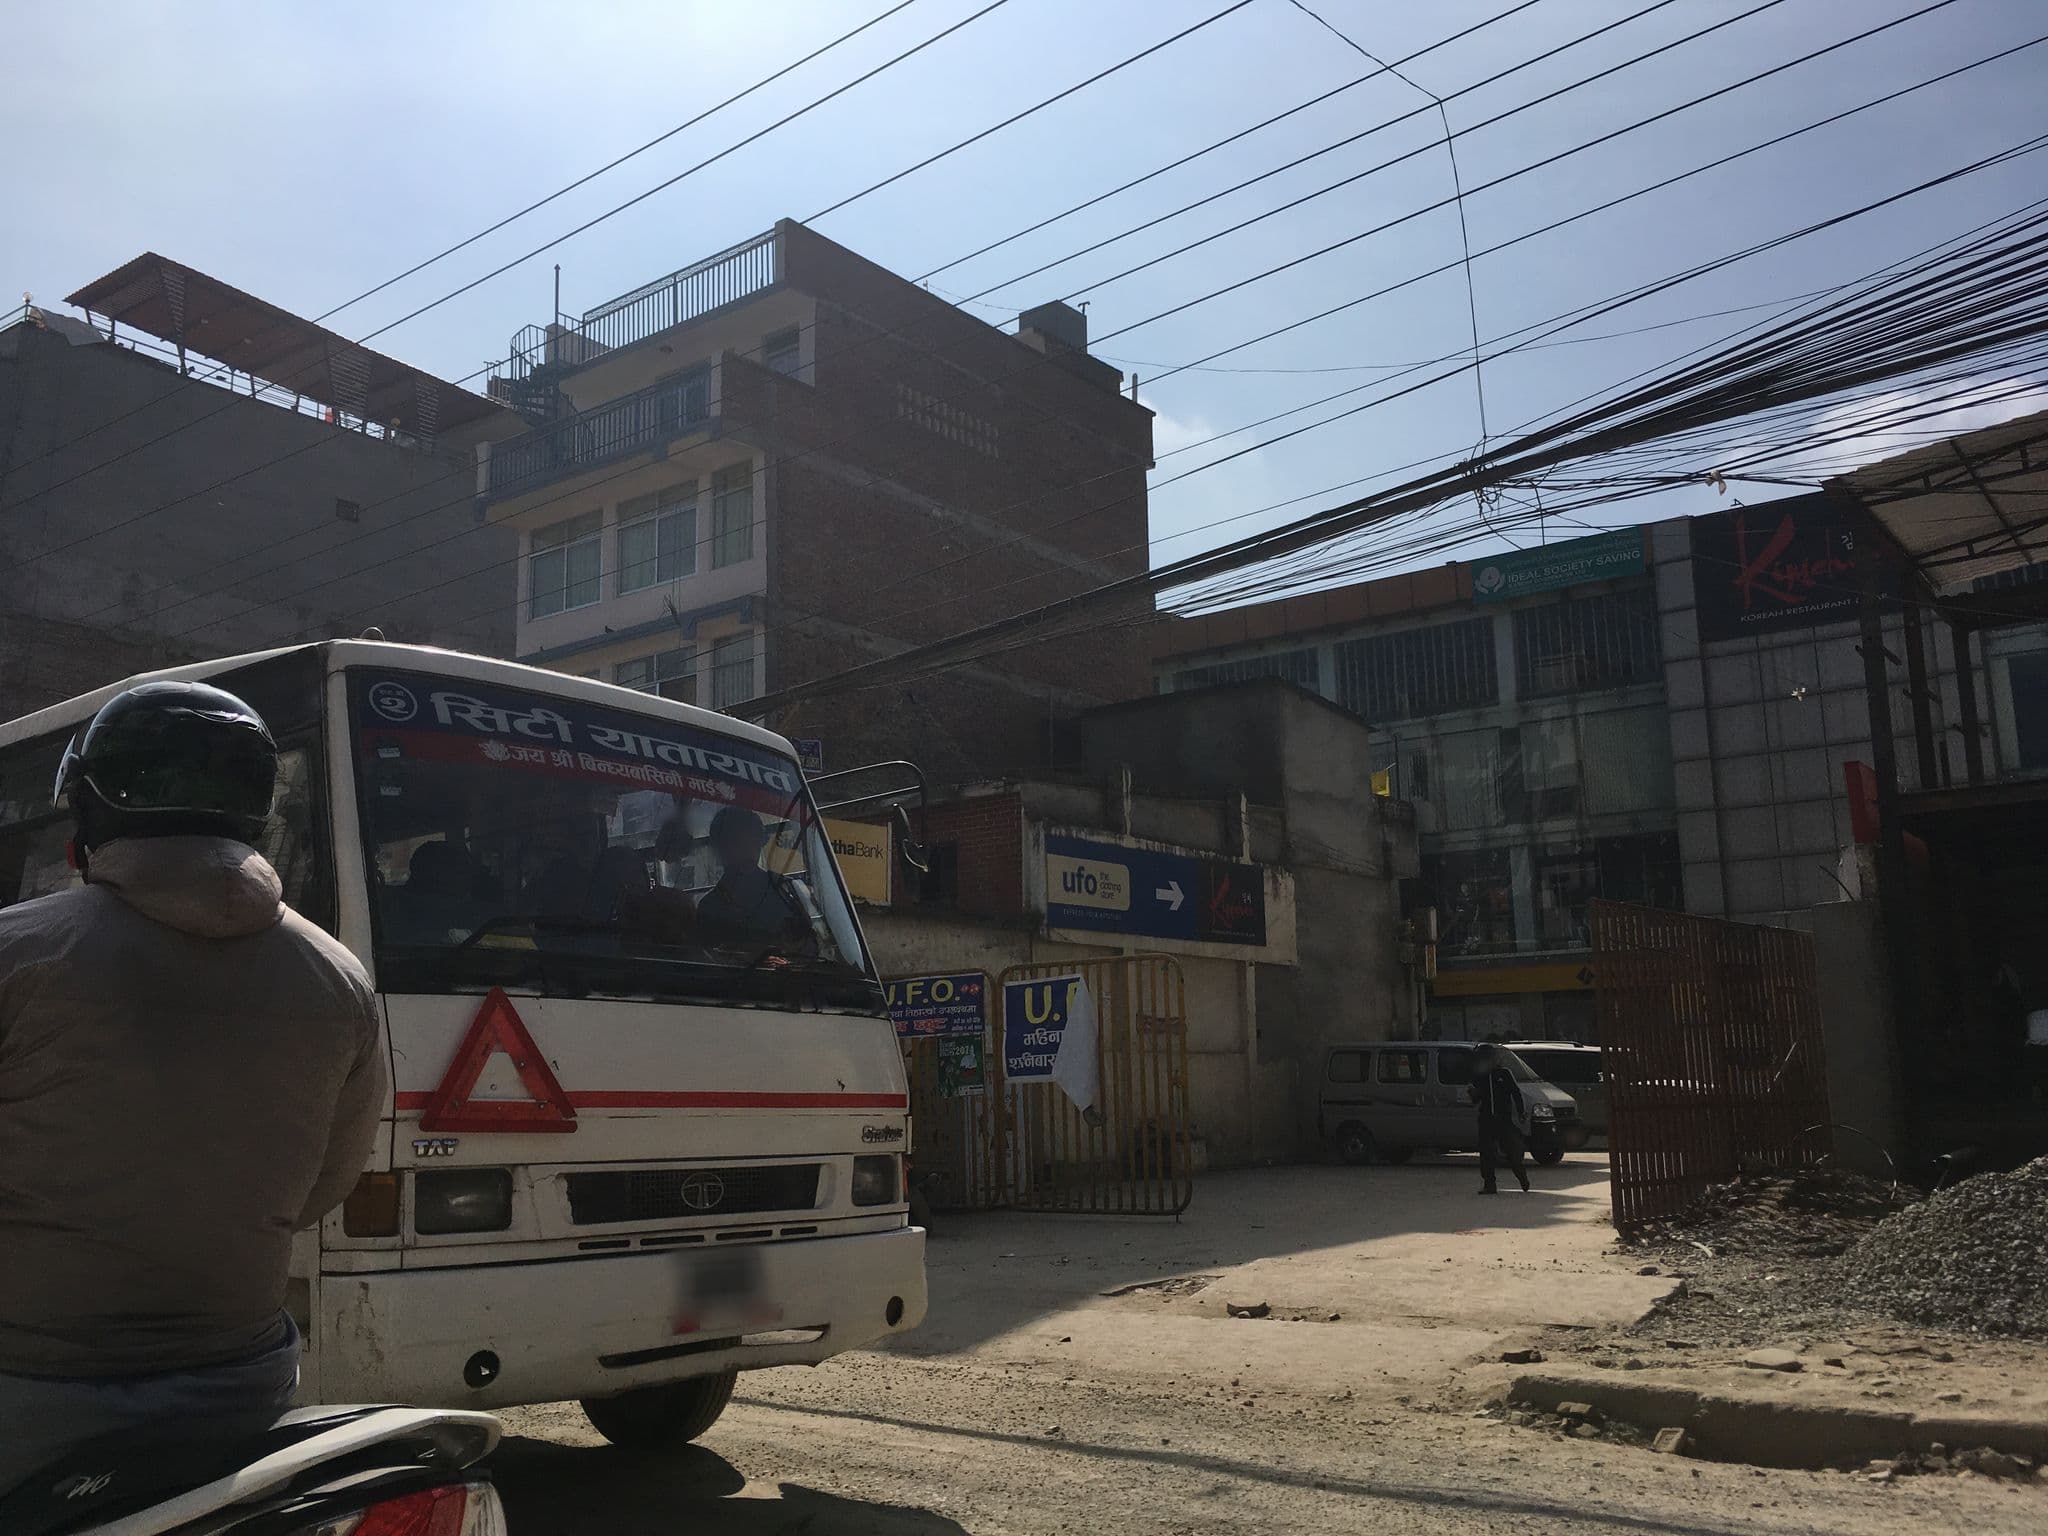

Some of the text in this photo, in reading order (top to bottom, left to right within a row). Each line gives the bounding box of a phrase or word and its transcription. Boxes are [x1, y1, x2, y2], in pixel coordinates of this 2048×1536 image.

[1507, 567, 1540, 585] IDEAL
[1544, 559, 1593, 577] SOCIETY
[1596, 549, 1641, 566] SAVING
[1740, 608, 1784, 623] KOREAN
[1786, 597, 1854, 615] RESTAURANT
[429, 691, 793, 793] सिटी यातायात
[511, 745, 546, 763] जय
[552, 749, 575, 769] श्री
[831, 839, 883, 859] thaBank
[1062, 866, 1097, 895] ufo
[412, 1139, 458, 1156] TAT
